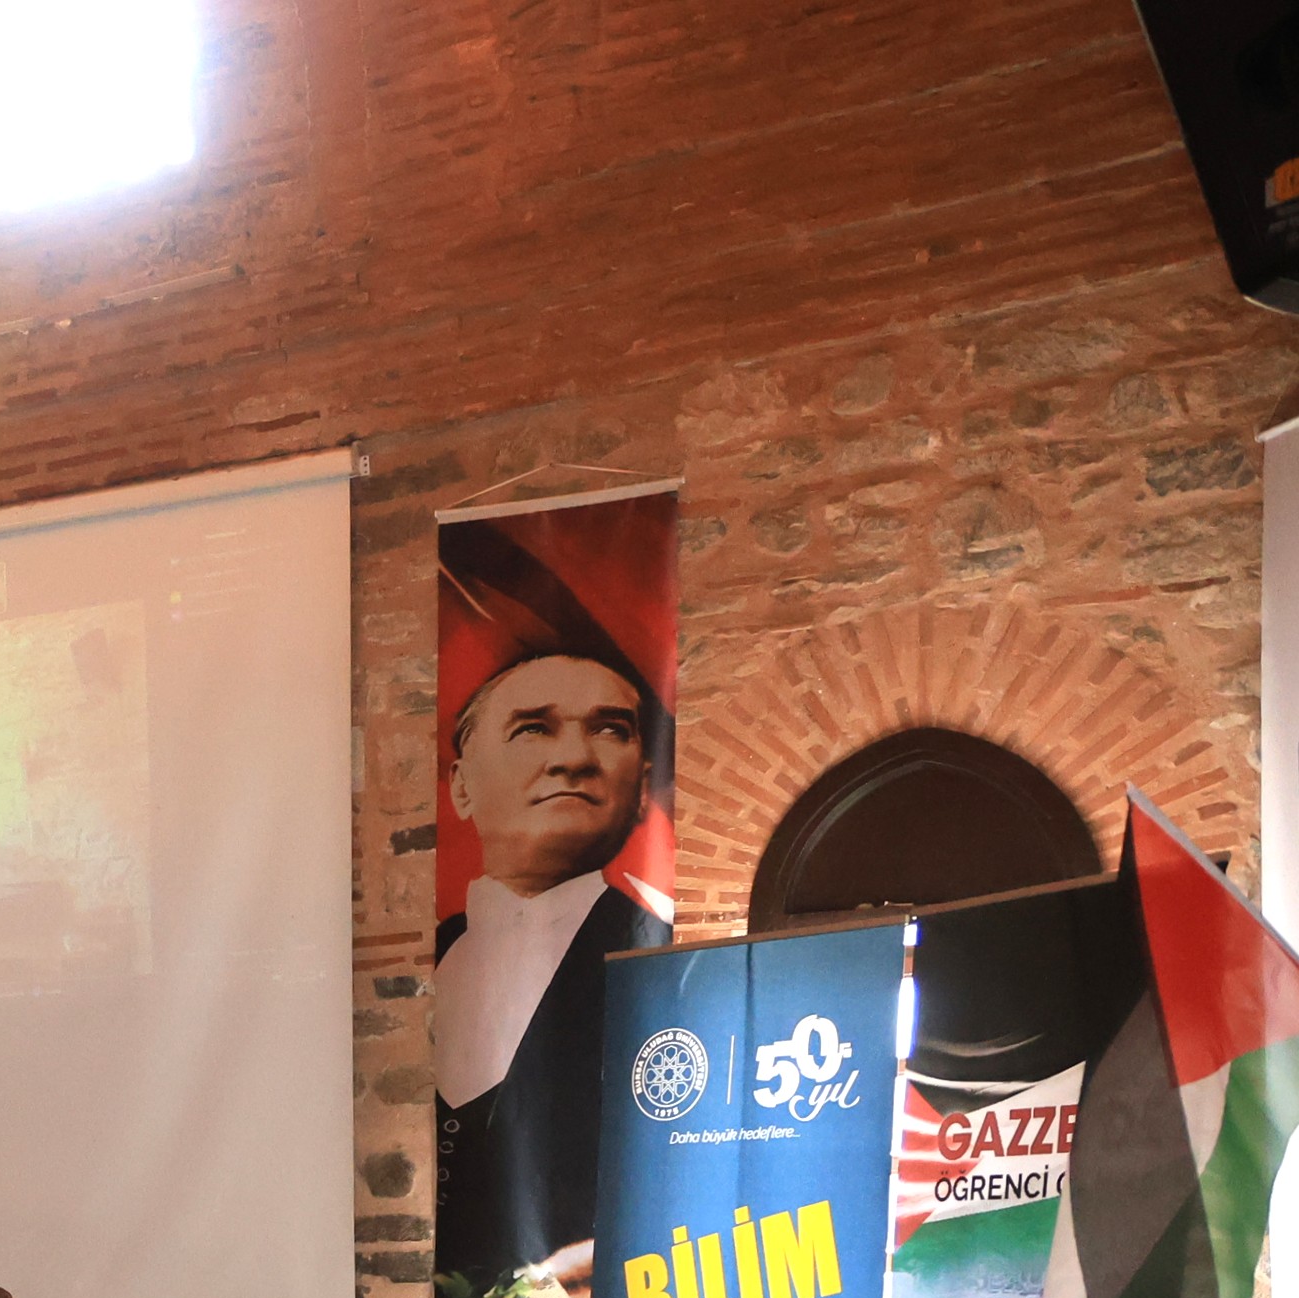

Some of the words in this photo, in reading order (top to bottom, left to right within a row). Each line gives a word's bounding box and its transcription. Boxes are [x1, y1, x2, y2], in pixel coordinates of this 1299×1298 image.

[641, 1032, 674, 1058] ULUDAĞ
[654, 1107, 679, 1116] 1975
[669, 1130, 700, 1145] Daha
[701, 1127, 737, 1145] büyük
[935, 1165, 1049, 1201] ÖĞRENCİ
